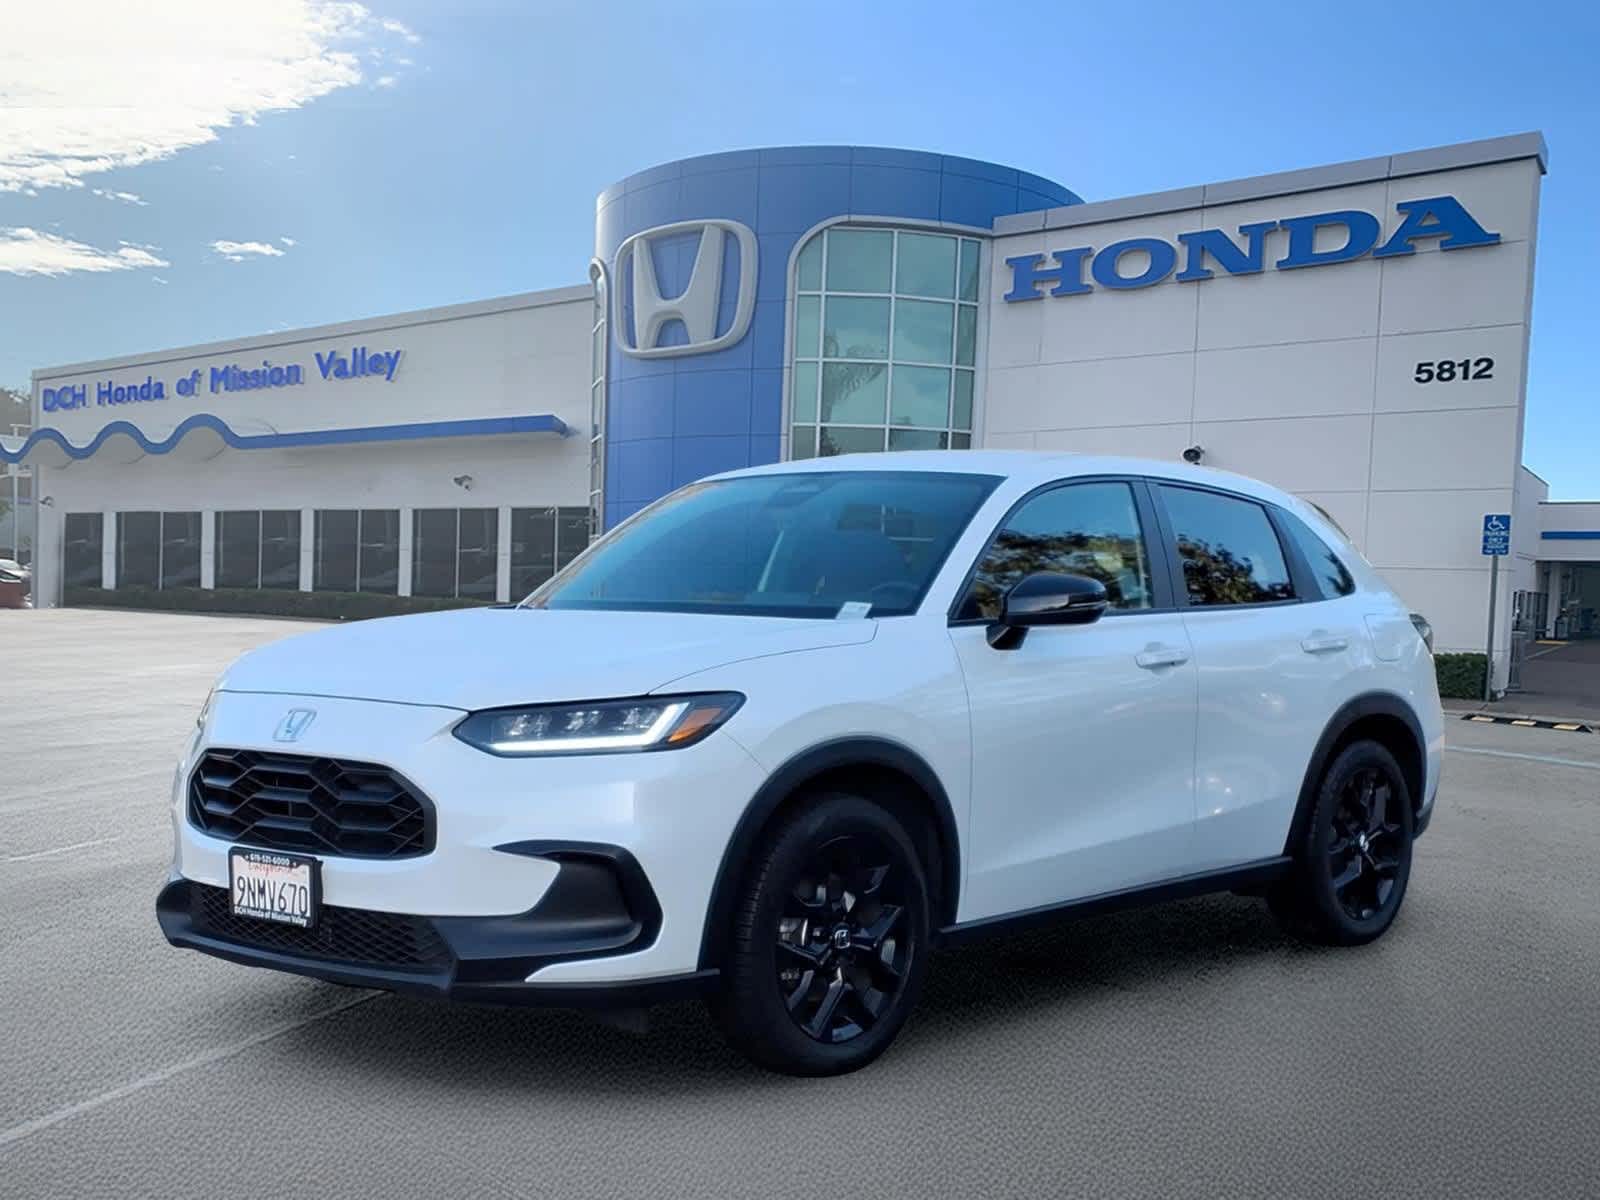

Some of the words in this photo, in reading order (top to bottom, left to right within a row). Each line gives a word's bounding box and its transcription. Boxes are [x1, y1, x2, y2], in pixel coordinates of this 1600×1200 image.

[1004, 196, 1500, 302] HONDA
[43, 384, 87, 412] DCH
[96, 376, 165, 406] Honda
[176, 369, 200, 397] of
[209, 360, 302, 393] Mission
[314, 347, 401, 383] Valley
[1414, 357, 1495, 384] 5812
[237, 875, 308, 917] 9NMV670
